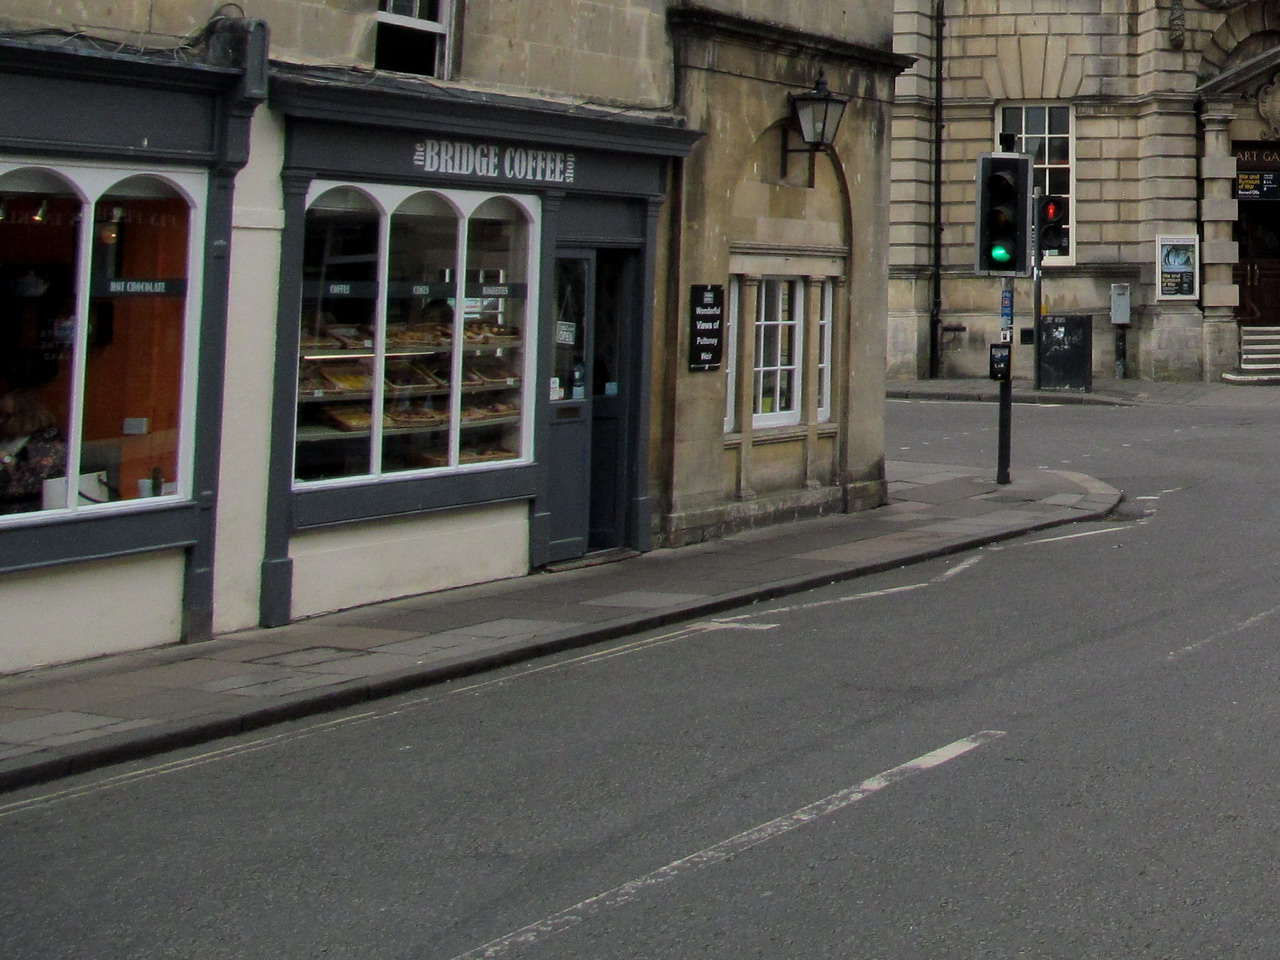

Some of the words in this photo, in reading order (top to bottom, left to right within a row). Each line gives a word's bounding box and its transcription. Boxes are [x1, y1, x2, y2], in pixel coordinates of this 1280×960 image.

[1236, 151, 1259, 161] ART
[413, 143, 426, 166] the
[424, 140, 499, 177] BRIDGE
[504, 147, 565, 183] COFFEE
[565, 153, 577, 183] shop
[110, 281, 125, 292] HOT
[126, 281, 166, 292] CHOCOLATE
[329, 284, 351, 294] COFFEE
[696, 307, 721, 315] Wonderful
[696, 320, 713, 330] Views
[713, 320, 720, 329] of
[558, 331, 574, 341] OPEN
